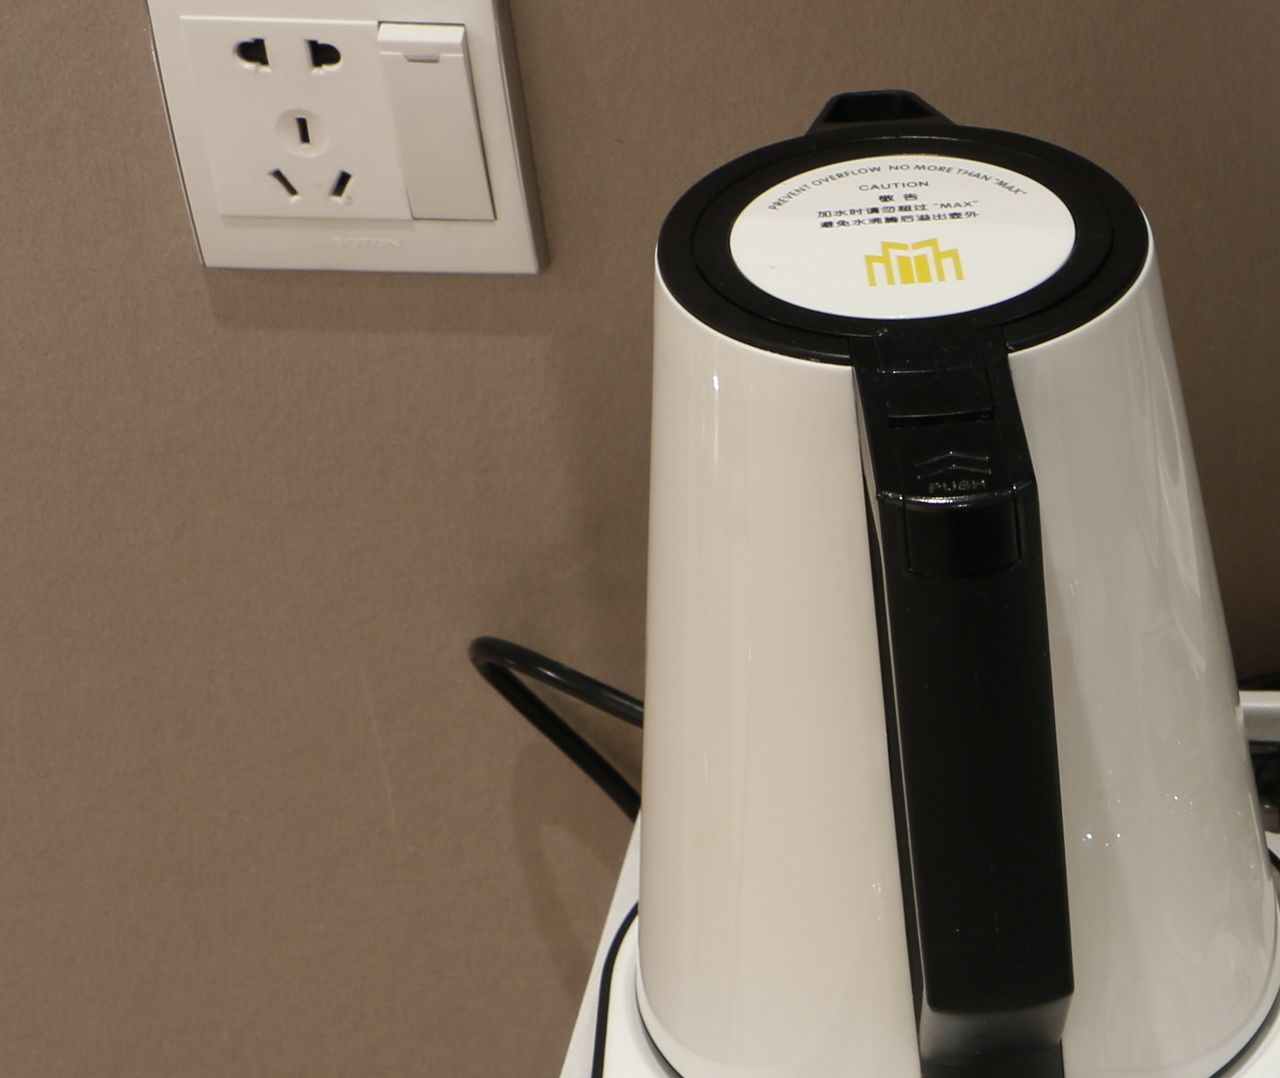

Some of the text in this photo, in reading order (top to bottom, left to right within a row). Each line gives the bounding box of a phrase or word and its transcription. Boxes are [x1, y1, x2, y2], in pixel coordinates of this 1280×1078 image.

[768, 184, 811, 210] PREVENT
[812, 166, 880, 186] OVERFLOW
[914, 164, 953, 174] MORE
[957, 168, 992, 180] THAN
[859, 181, 928, 192] CAUTION
